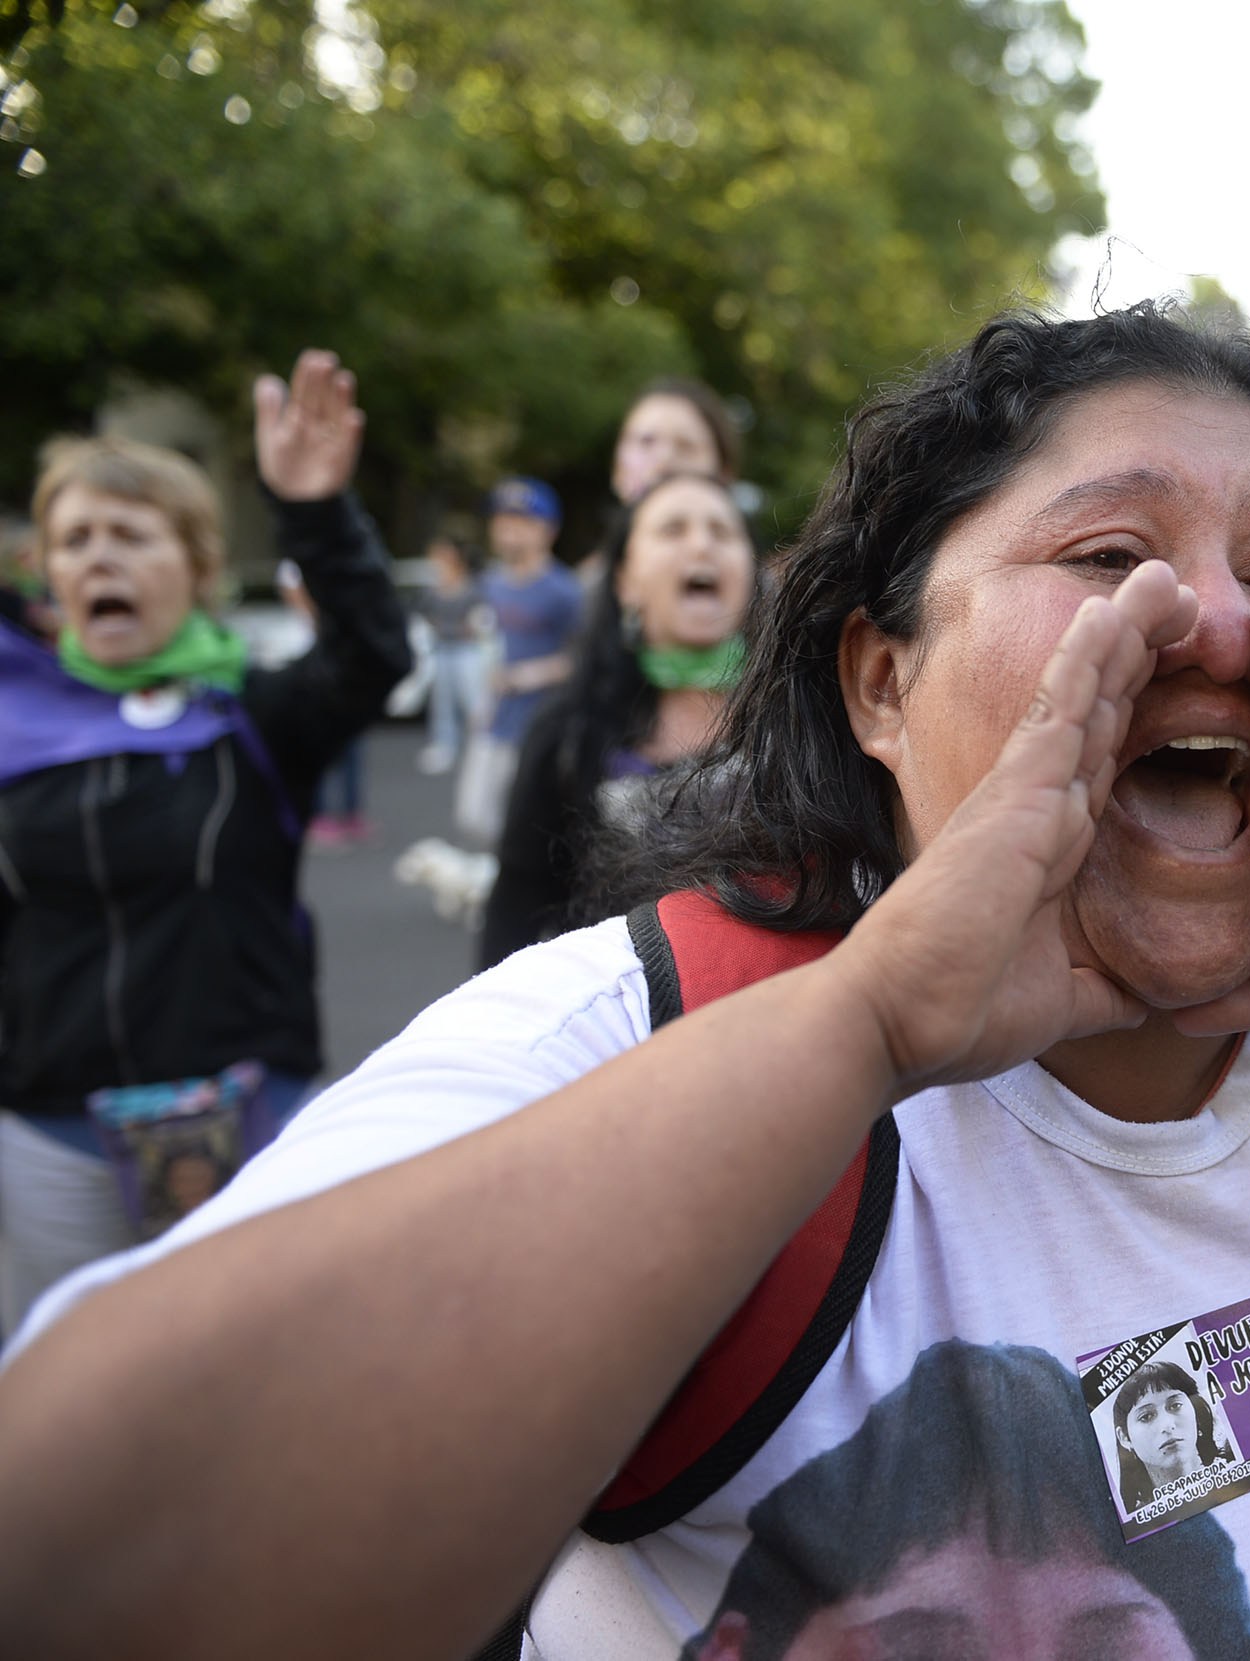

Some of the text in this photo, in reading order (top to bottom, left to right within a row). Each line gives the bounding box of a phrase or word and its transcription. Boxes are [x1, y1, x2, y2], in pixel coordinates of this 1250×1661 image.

[1096, 1338, 1139, 1377] ¿DÓNDE
[1097, 1331, 1167, 1397] MIERDA ESTÁ?
[1206, 1370, 1226, 1405] A
[1136, 1508, 1150, 1524] EL
[1151, 1503, 1166, 1518] 26
[1166, 1495, 1182, 1511] DE
[1183, 1479, 1214, 1502] JULIO
[1215, 1472, 1230, 1488] DE
[1153, 1461, 1227, 1501] DESAPARECIDA
